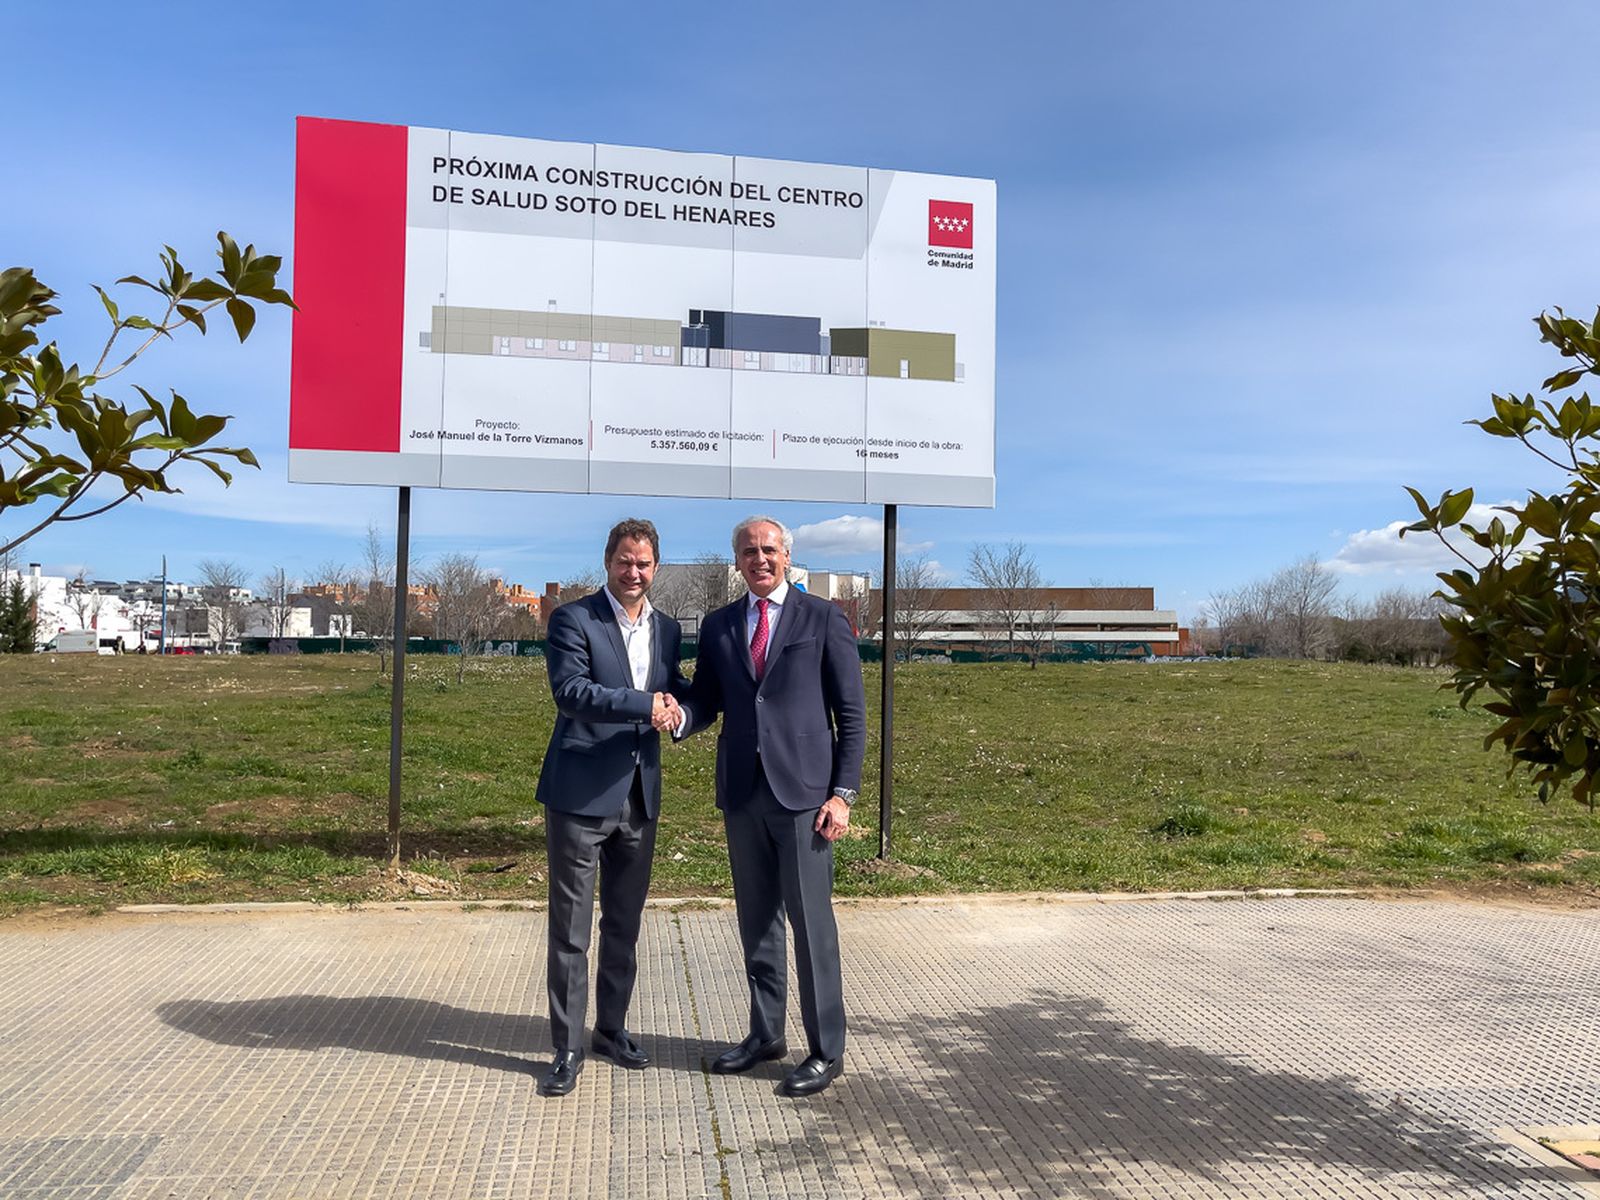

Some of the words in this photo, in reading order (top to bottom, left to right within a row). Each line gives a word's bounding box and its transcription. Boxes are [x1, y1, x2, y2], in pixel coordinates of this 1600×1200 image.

[432, 155, 539, 182] PRÓXIMA
[545, 166, 723, 198] CONSTRUCCIÓN
[730, 182, 771, 201] DEL
[777, 187, 864, 209] CENTRO
[432, 185, 464, 204] DE
[471, 188, 548, 211] SALUD
[555, 196, 617, 216] SOTO
[624, 201, 666, 220] DEL
[673, 207, 776, 229] HENARES
[927, 249, 974, 260] Comunidad
[927, 259, 940, 267] de
[941, 260, 974, 269] Madrid
[475, 419, 521, 431] Proyecto:
[409, 429, 435, 440] José
[437, 431, 475, 442] Manuel
[477, 432, 491, 442] de
[493, 433, 502, 442] la
[505, 433, 532, 443] Torre
[535, 435, 584, 446] Vizmanos
[604, 425, 662, 437] Presupuesto
[665, 428, 706, 438] estimado
[708, 430, 720, 439] de
[722, 431, 765, 441] licitación:
[650, 440, 710, 452] 5.357.560,09
[712, 442, 719, 451] €
[782, 433, 807, 444] Plazo
[809, 435, 821, 444] de
[823, 436, 864, 447] ejecución
[867, 437, 893, 447] desde
[896, 439, 917, 449] inicio
[919, 440, 931, 449] de
[932, 441, 939, 449] la
[942, 441, 964, 450] obra:
[869, 451, 899, 460] meses
